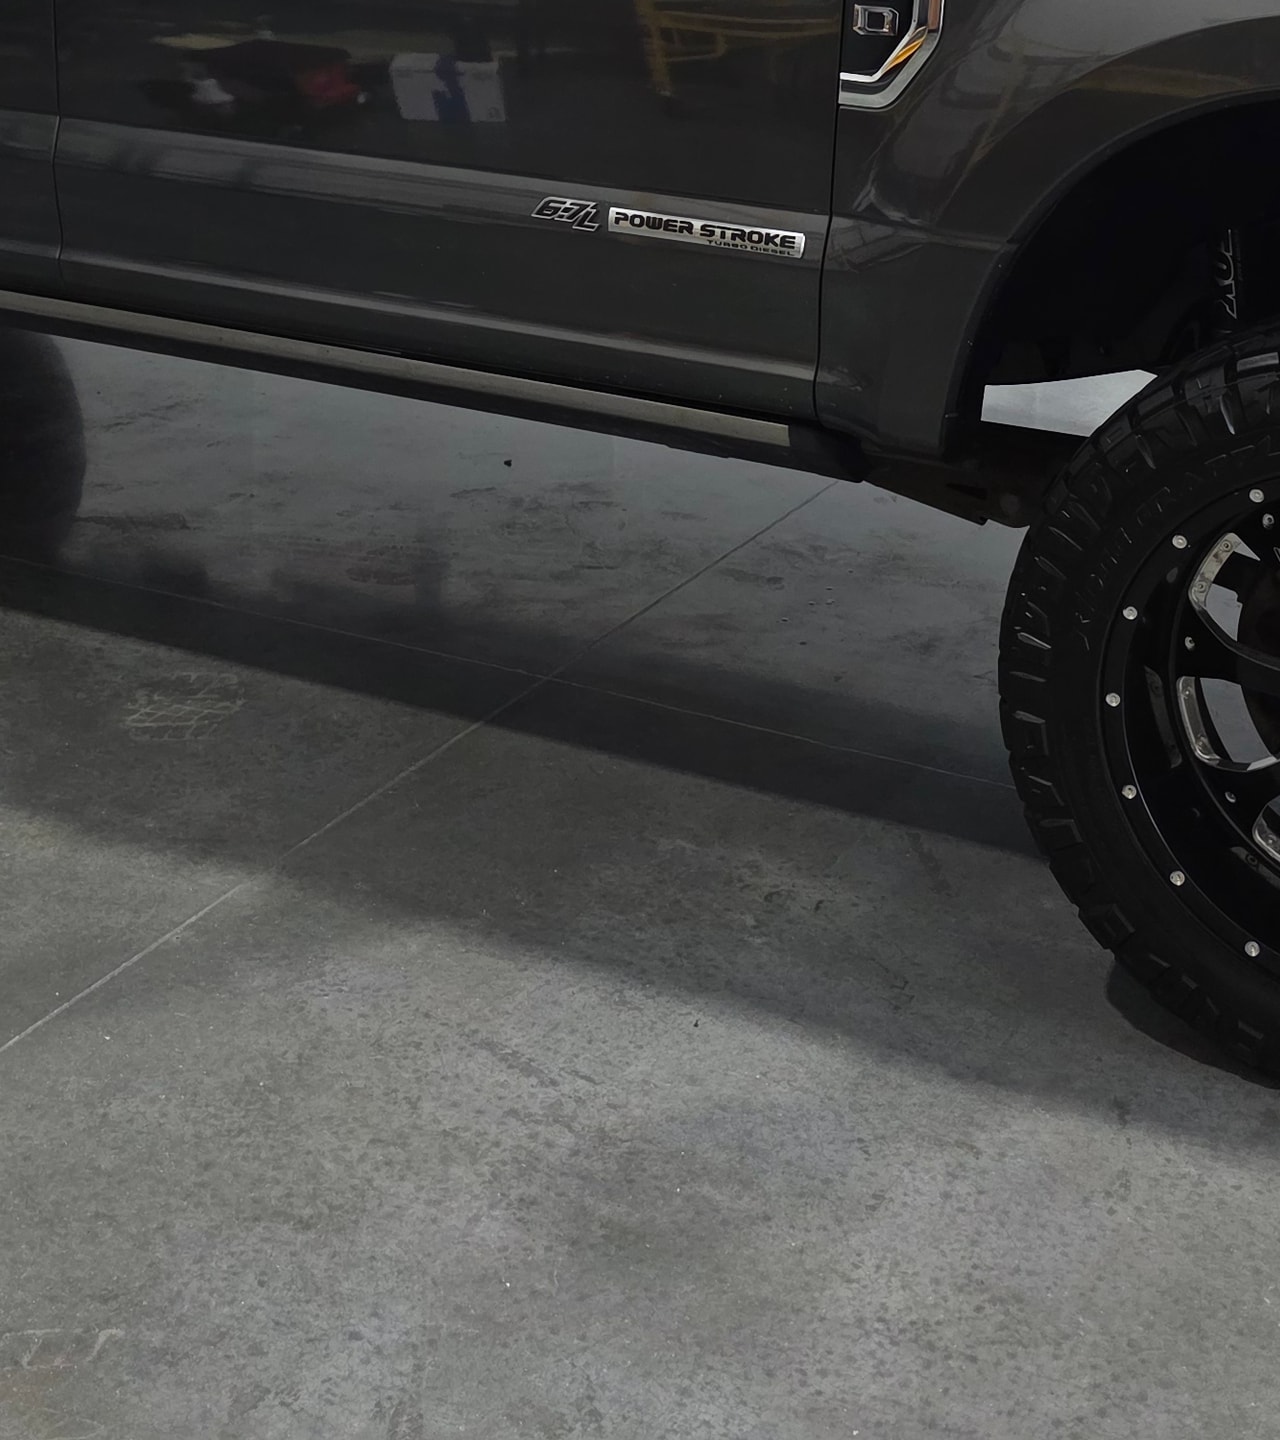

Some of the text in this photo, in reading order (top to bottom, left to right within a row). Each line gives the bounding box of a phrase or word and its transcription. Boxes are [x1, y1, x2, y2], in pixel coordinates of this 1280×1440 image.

[531, 196, 603, 231] 6.7L
[613, 210, 797, 250] POWER STROKE
[706, 239, 796, 257] TURBO DIESEL
